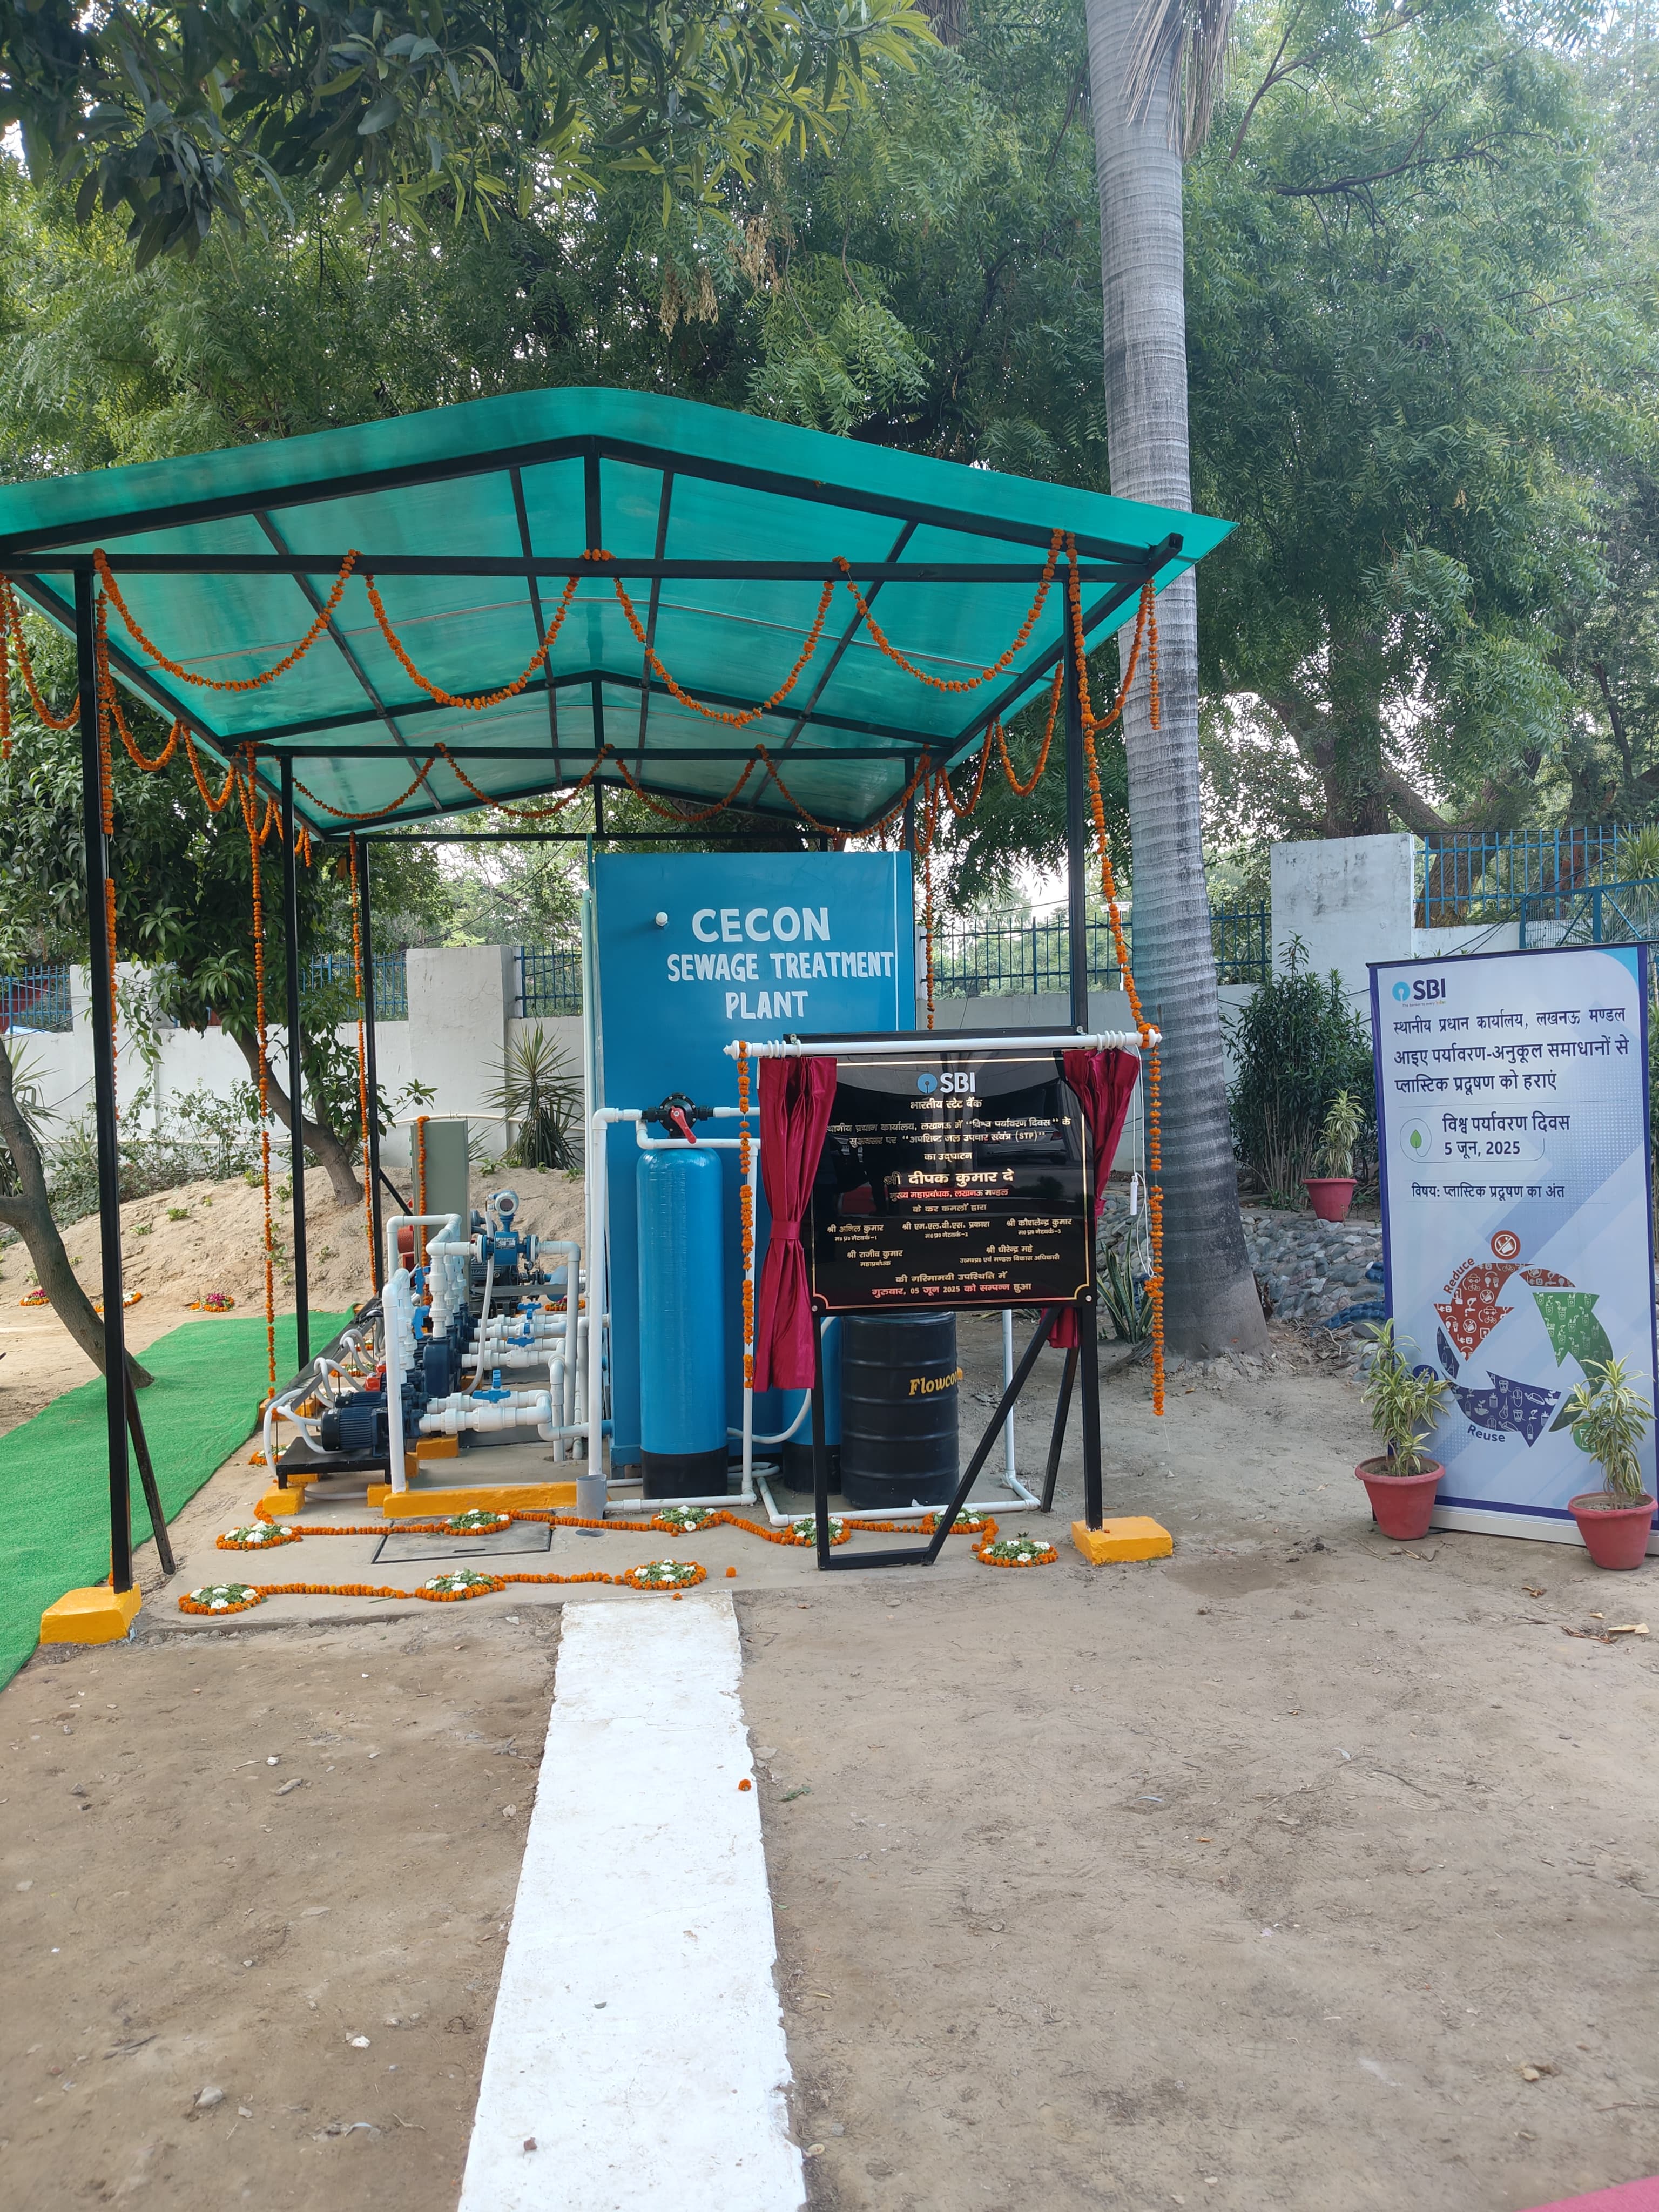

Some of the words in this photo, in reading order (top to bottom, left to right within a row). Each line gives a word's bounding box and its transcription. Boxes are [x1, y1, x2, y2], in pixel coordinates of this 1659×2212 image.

[692, 907, 830, 942] CECON
[667, 953, 759, 982] SEWAGE
[770, 952, 894, 979] TREATMENT
[1413, 978, 1446, 1000] SBI
[726, 991, 808, 1019] PLANT
[1393, 1015, 1431, 1035] स्थानीय
[1439, 1017, 1469, 1032] प्रधान
[1476, 1009, 1528, 1029] कार्यालय,
[1536, 1010, 1580, 1026] लखनऊ
[1589, 1008, 1625, 1023] मण्डल
[1394, 1050, 1428, 1067] आइए
[1432, 1042, 1543, 1063] पर्यावरण-अनुकूल
[1547, 1035, 1611, 1057] समाधानों
[1615, 1034, 1629, 1055] से
[940, 1072, 975, 1093] SBI
[1394, 1074, 1449, 1094] प्लास्टिक
[1453, 1076, 1495, 1095] प्रदूषण
[1499, 1069, 1518, 1089] को
[1522, 1069, 1557, 1091] हराएं
[911, 1097, 942, 1109] भारतीय
[946, 1098, 963, 1109] स्टेट
[966, 1096, 983, 1108] बैंक
[855, 1124, 877, 1132] प्रधान
[881, 1121, 917, 1131] कार्यालय,
[920, 1122, 952, 1130] लखनऊ
[955, 1120, 963, 1129] में
[995, 1117, 1027, 1127] पर्यावरण
[1061, 1116, 1071, 1126] के
[1442, 1112, 1468, 1134] विश्व
[1472, 1111, 1528, 1131] पर्यावरण
[1532, 1110, 1570, 1132] दिवस
[991, 1131, 1011, 1141] संयंत्र
[924, 1153, 935, 1161] का
[1445, 1142, 1452, 1155] 5
[1456, 1141, 1481, 1159] जून,
[1486, 1141, 1520, 1155] 2025
[883, 1171, 903, 1185] श्री
[908, 1171, 950, 1184] दीपक
[955, 1172, 998, 1187] कुमार
[1002, 1168, 1015, 1181] दे
[889, 1192, 908, 1201] मुख्य
[1412, 1182, 1440, 1197] विषय:
[1443, 1182, 1486, 1197] प्लास्टिक
[1489, 1186, 1523, 1201] प्रदूषण
[1526, 1186, 1542, 1197] का
[1546, 1183, 1565, 1197] अंत
[912, 1204, 922, 1213] के
[941, 1203, 969, 1211] कमलों
[827, 1224, 837, 1233] श्री
[839, 1224, 861, 1232] अनिल
[863, 1225, 884, 1233] कुमार
[902, 1222, 912, 1230] श्री
[1006, 1218, 1016, 1227] श्री
[1018, 1217, 1049, 1226] कौशलेन्द्र
[1052, 1218, 1072, 1228] कुमार
[847, 1250, 857, 1258] श्री
[859, 1249, 880, 1258] राजीव
[882, 1250, 903, 1259] कुमार
[986, 1245, 995, 1253] श्री
[998, 1244, 1019, 1253] धीरेन्द्र
[895, 1274, 908, 1283] की
[911, 1272, 954, 1283] गरिमामयी
[957, 1271, 995, 1280] उपस्थिति
[998, 1271, 1008, 1279] में
[1443, 1258, 1475, 1294] Reduce
[872, 1287, 906, 1298] गुरुवार,
[922, 1286, 940, 1296] जून
[963, 1283, 976, 1292] को
[1013, 1283, 1031, 1293] हुआ
[1467, 1424, 1506, 1442] Reuse
